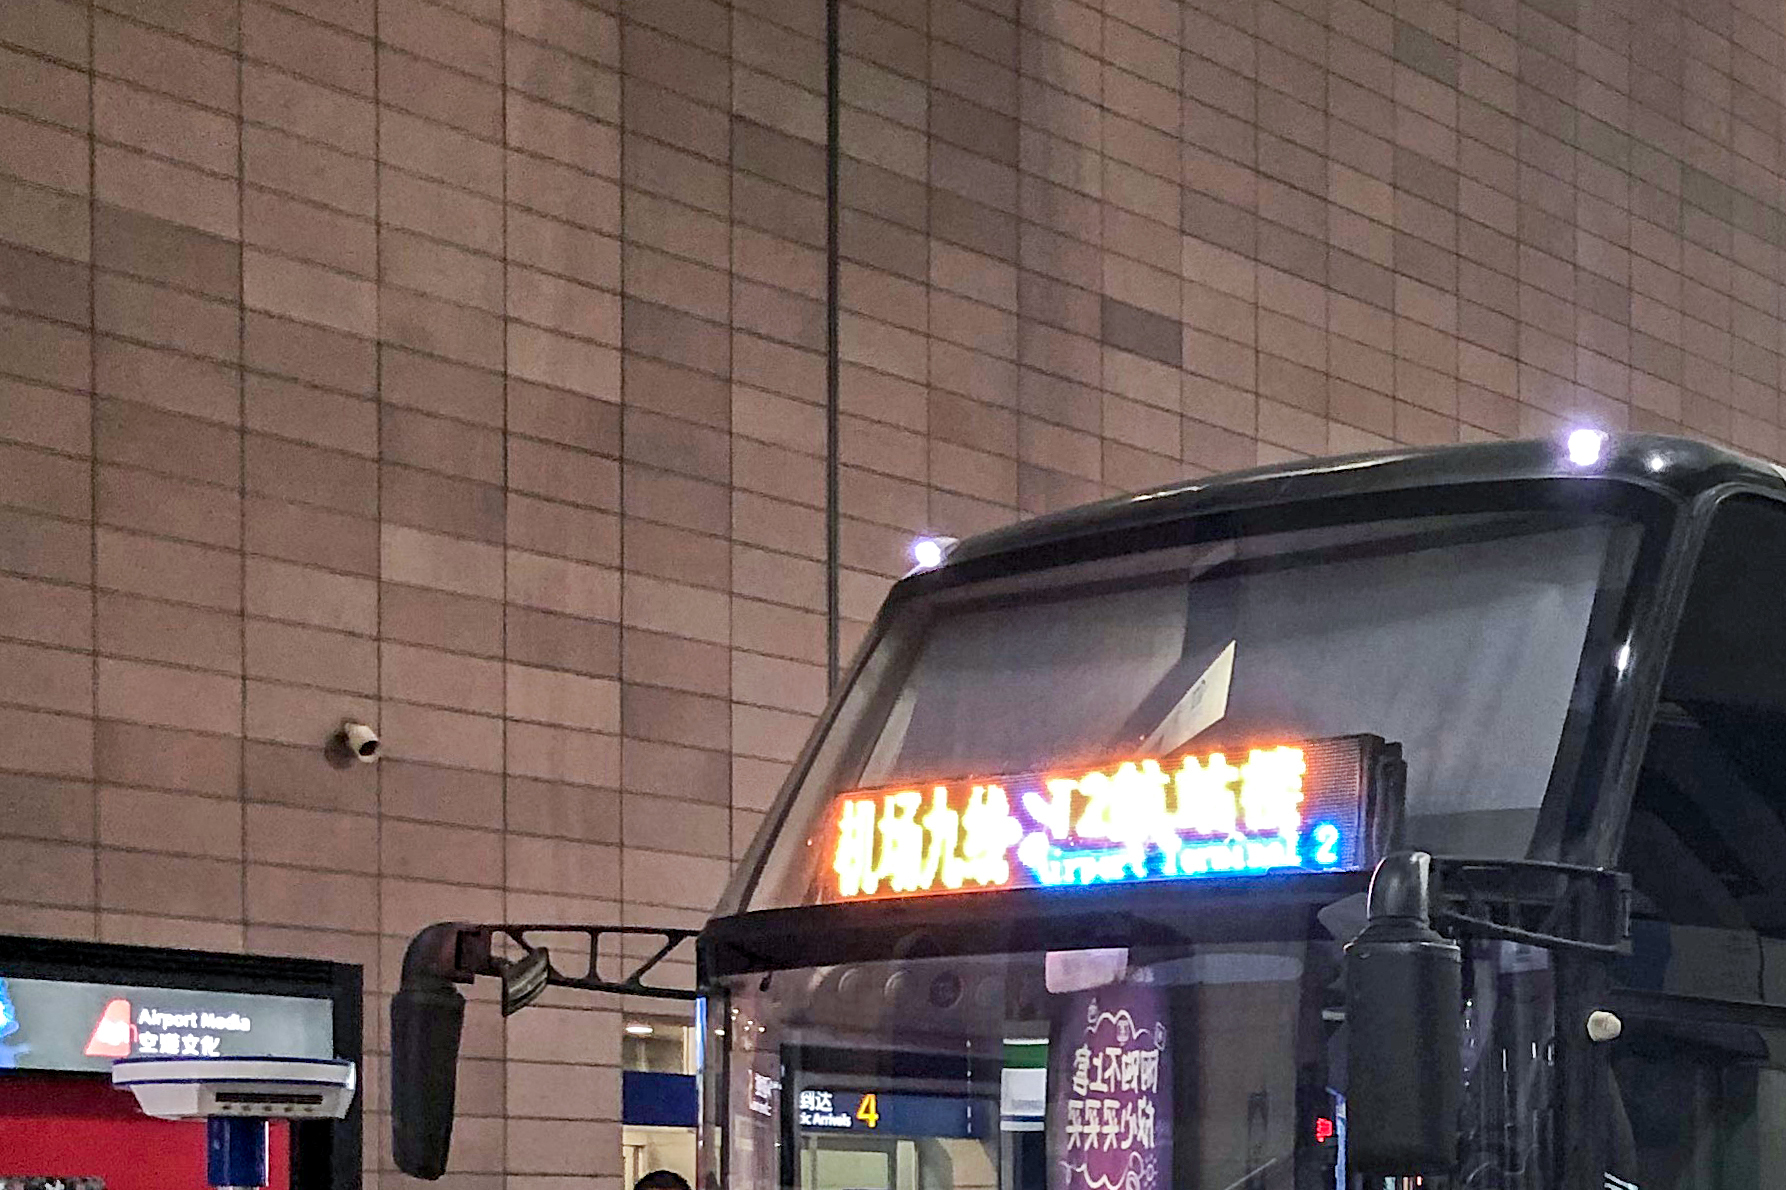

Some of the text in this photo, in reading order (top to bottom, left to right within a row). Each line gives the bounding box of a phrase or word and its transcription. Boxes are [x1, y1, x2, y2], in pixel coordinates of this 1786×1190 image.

[1316, 824, 1339, 863] 2
[138, 1008, 251, 1032] Airport Media
[856, 1093, 879, 1128] 4
